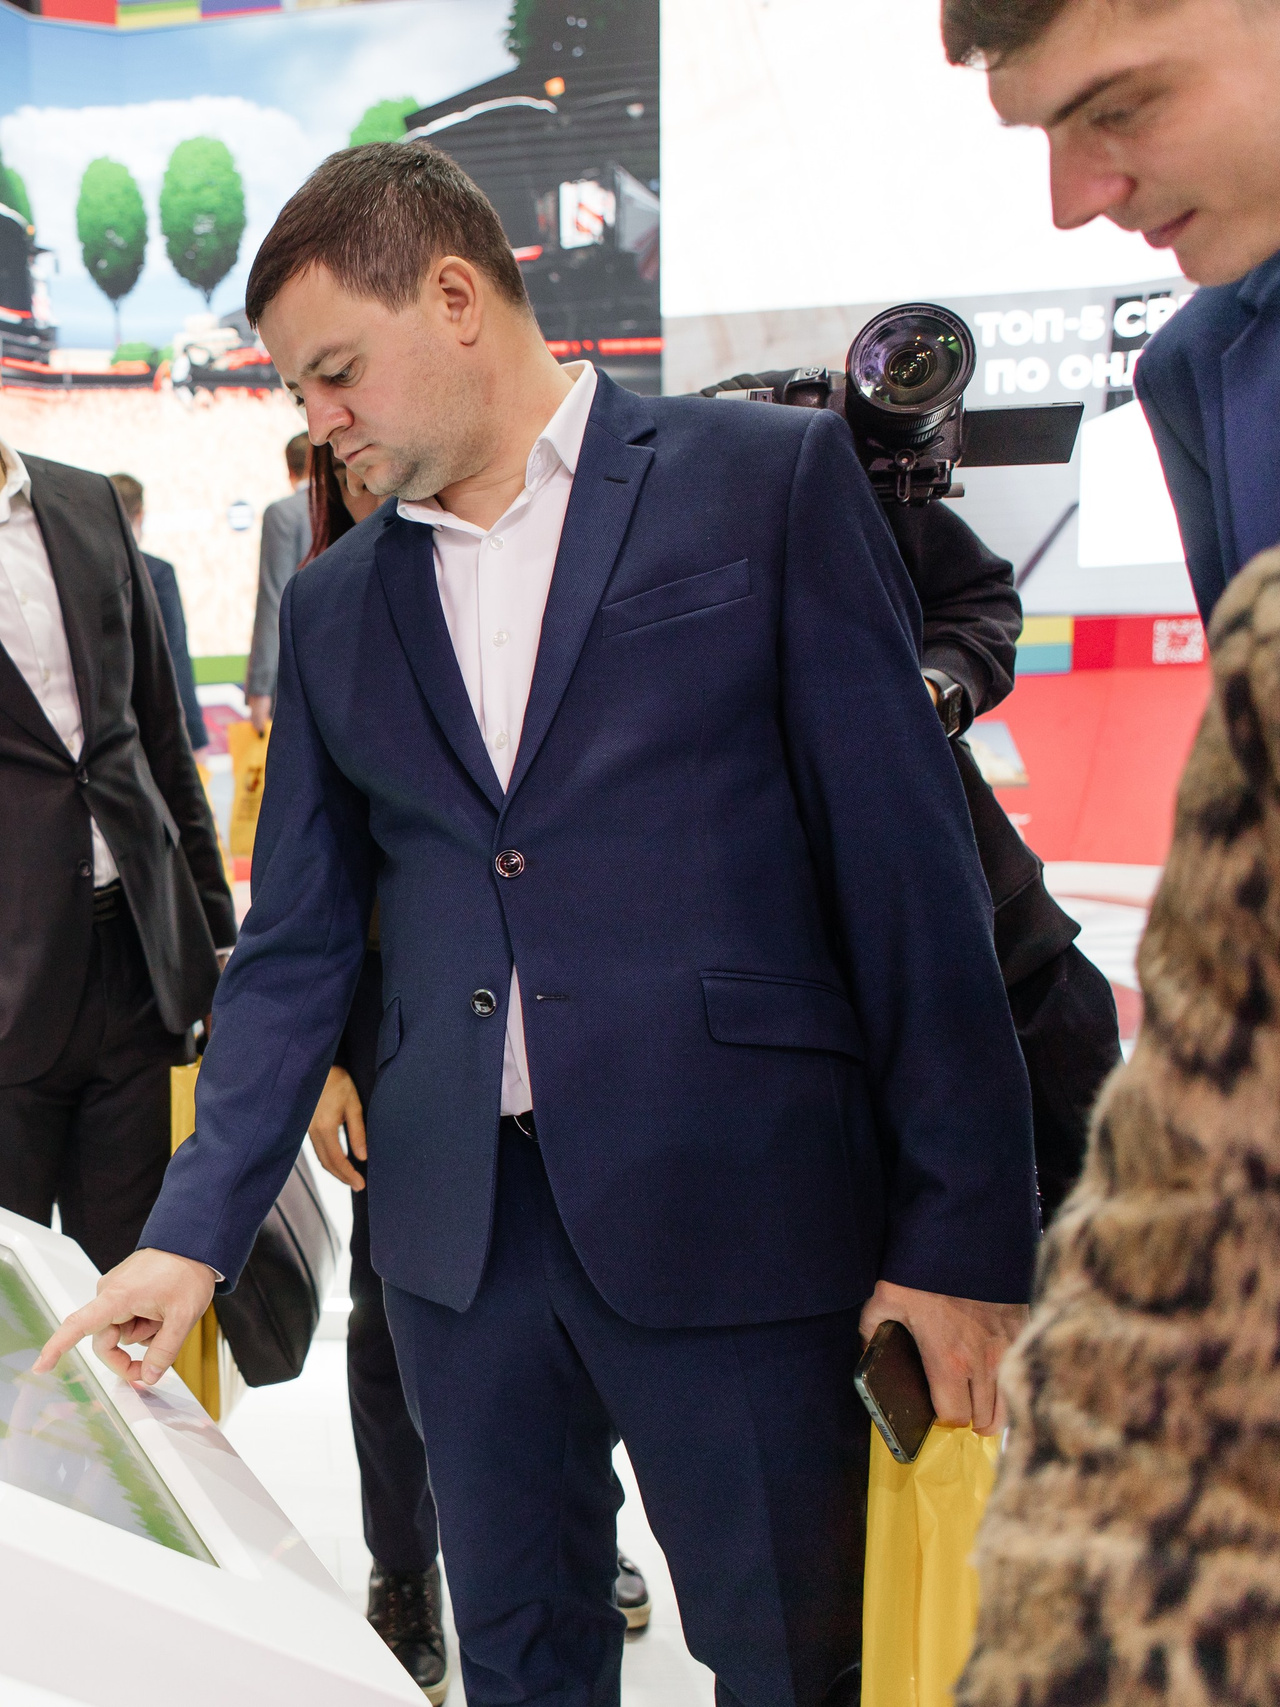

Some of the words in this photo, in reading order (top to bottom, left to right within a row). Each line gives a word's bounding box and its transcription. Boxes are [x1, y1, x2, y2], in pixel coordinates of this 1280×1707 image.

[974, 305, 1106, 348] ТОП-5
[1113, 294, 1195, 338] СР
[984, 356, 1051, 395] ПО
